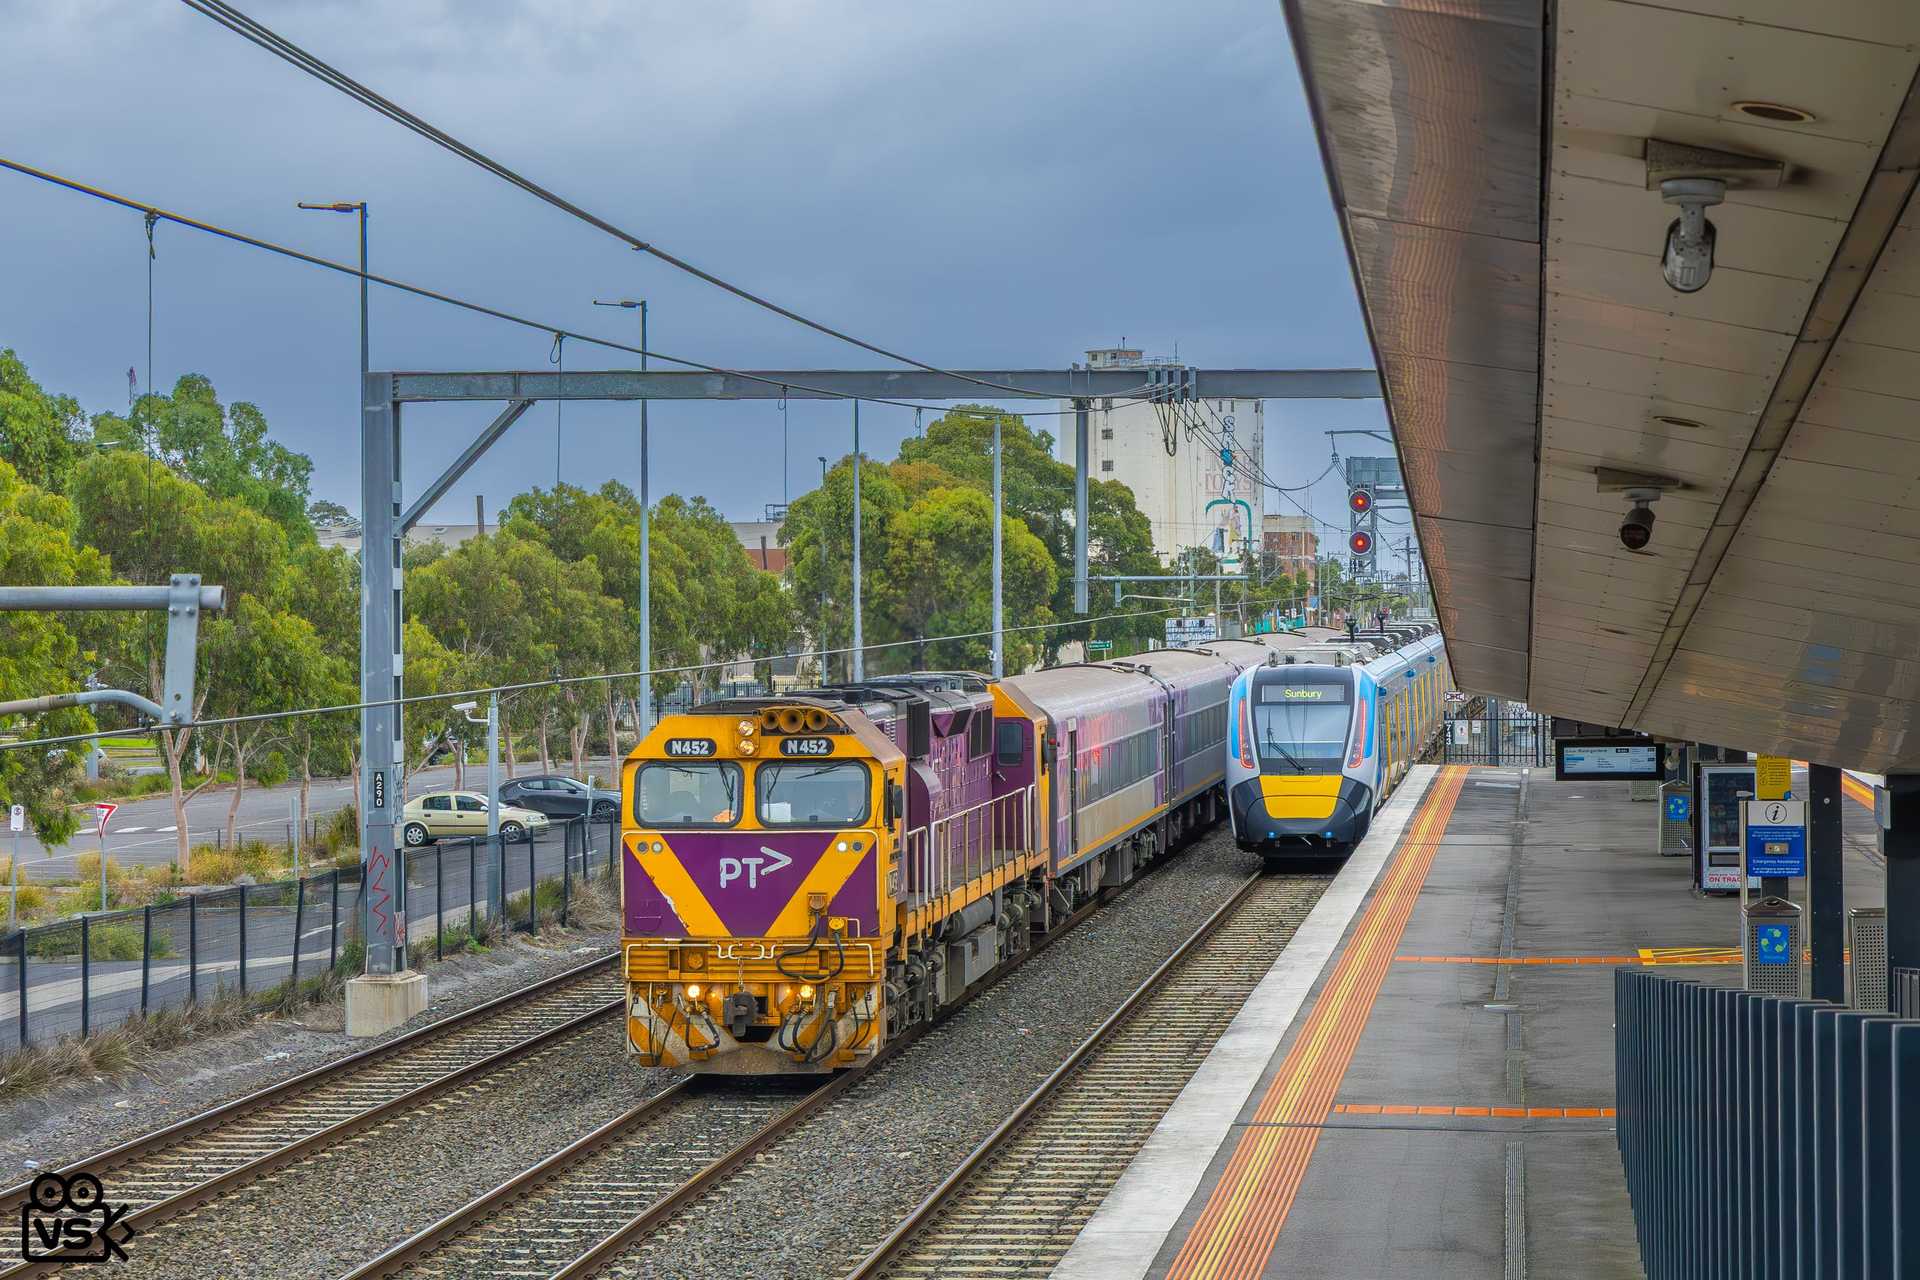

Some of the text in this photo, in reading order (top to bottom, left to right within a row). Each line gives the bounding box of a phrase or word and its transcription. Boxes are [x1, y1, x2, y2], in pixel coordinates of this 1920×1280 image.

[1284, 688, 1322, 699] Sunbury
[671, 740, 709, 755] N452
[375, 772, 383, 807] A290
